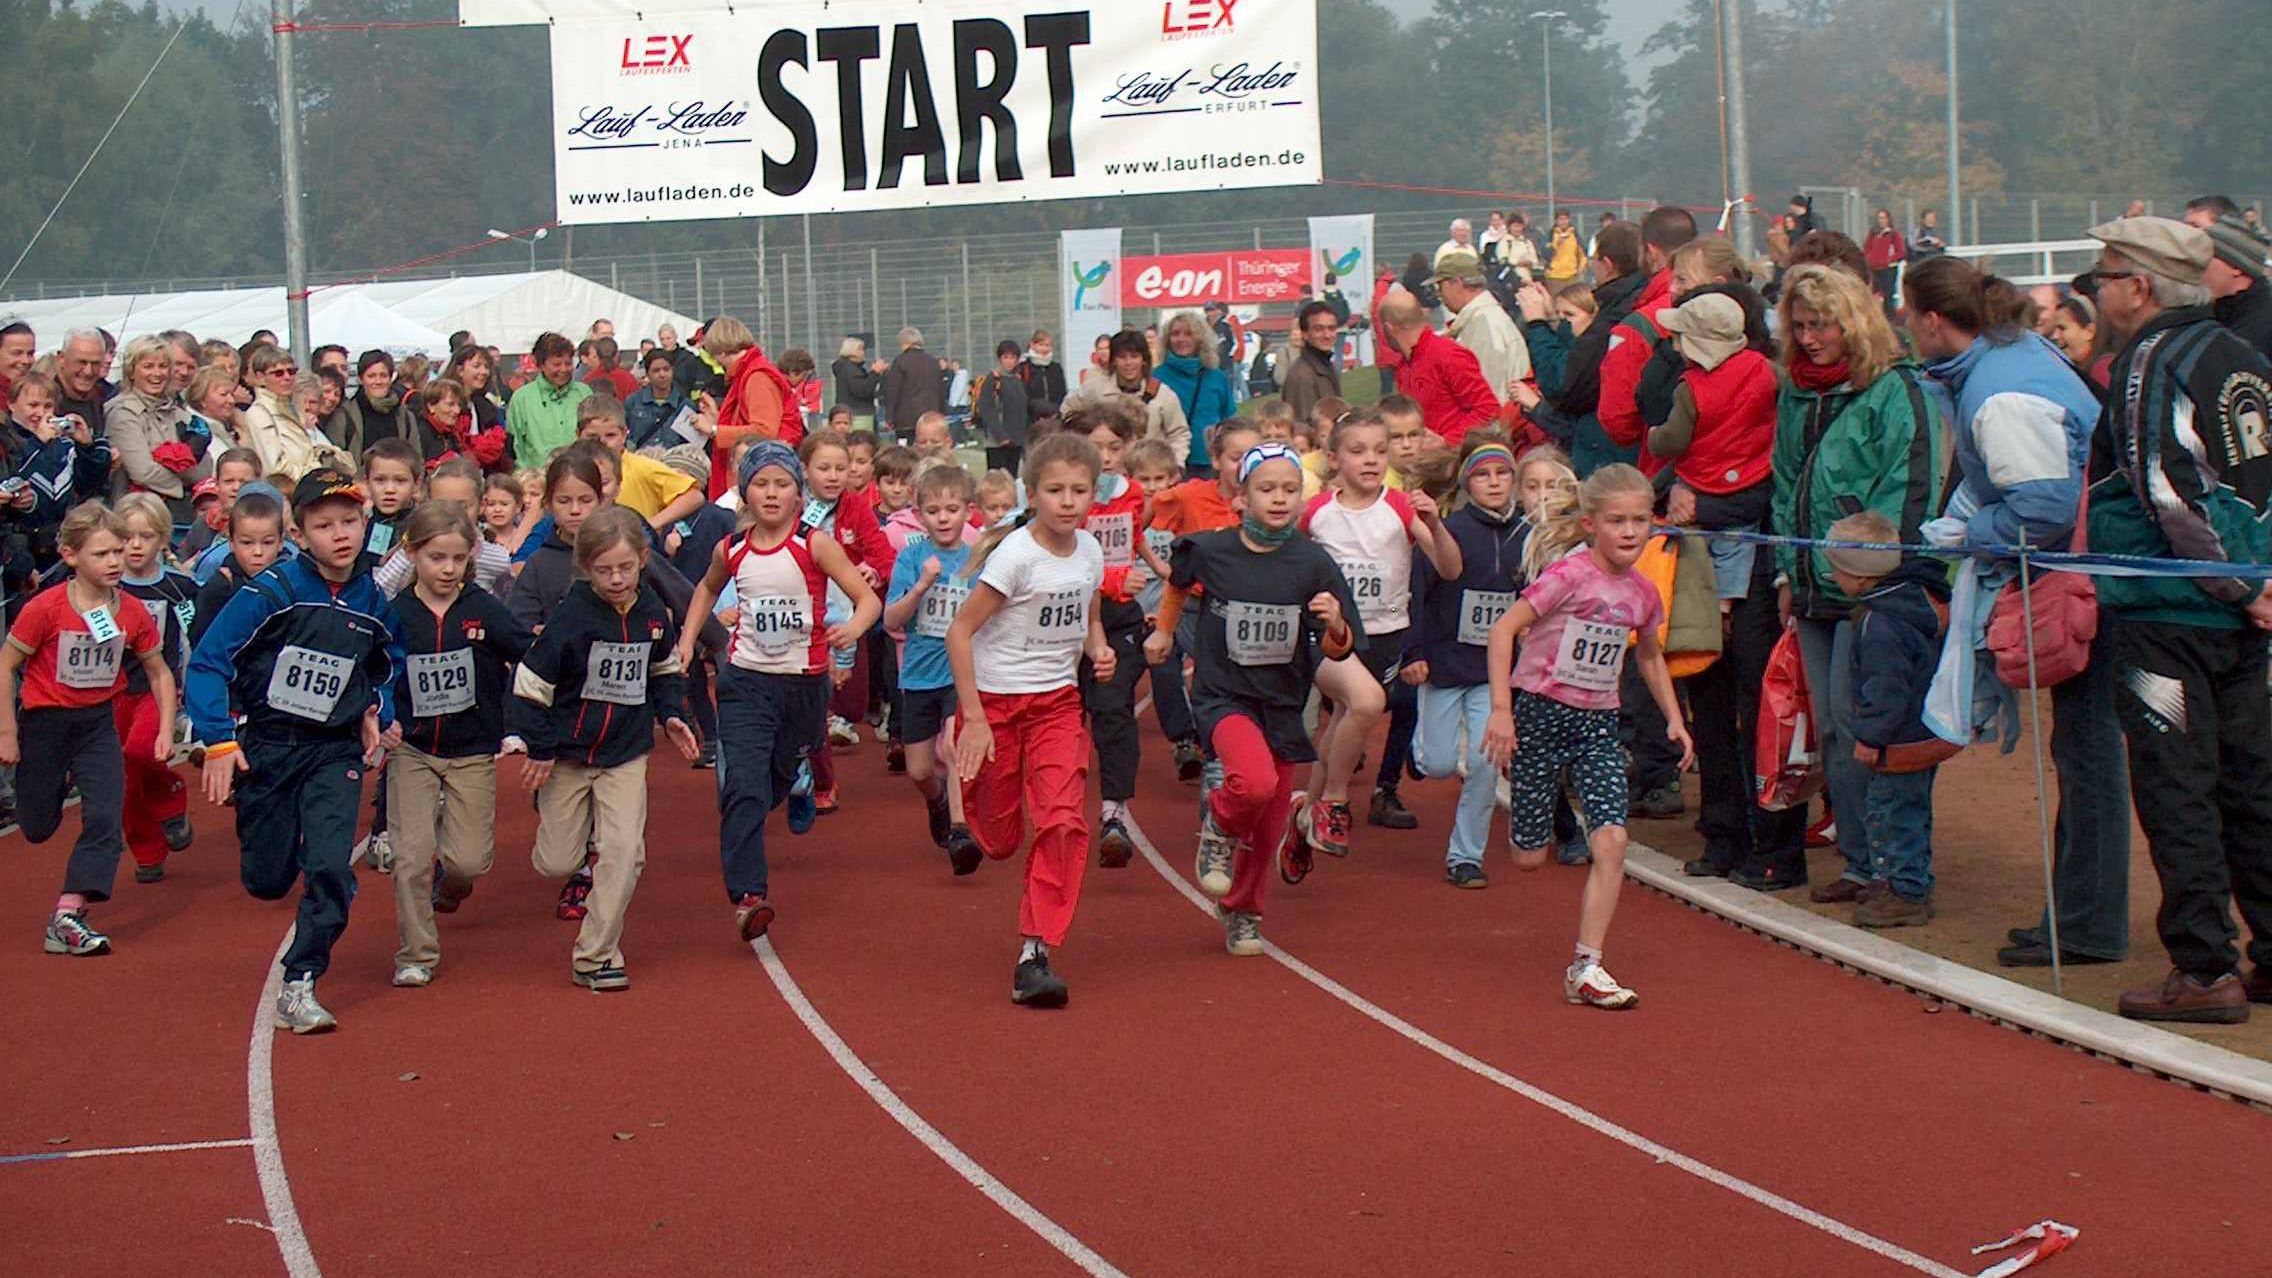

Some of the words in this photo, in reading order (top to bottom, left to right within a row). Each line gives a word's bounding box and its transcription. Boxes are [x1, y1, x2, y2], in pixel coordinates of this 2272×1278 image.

[1162, 0, 1237, 33] LEX
[622, 34, 694, 68] LEX
[757, 9, 1091, 197] START
[1205, 100, 1268, 114] ERFURT
[663, 138, 702, 150] JENA
[1104, 149, 1305, 175] www.laufladen.de
[569, 183, 754, 205] www.laufladen.de
[1237, 259, 1301, 278] Thüringer
[1238, 278, 1289, 297] Energie
[1048, 589, 1081, 600] TEAC
[1346, 577, 1382, 597] 126
[760, 598, 797, 606] TEAC
[927, 597, 963, 619] 811
[1243, 605, 1285, 615] TEAC
[90, 610, 113, 638] 8114
[756, 611, 804, 632] 8145
[1039, 602, 1083, 628] 8154
[1472, 606, 1506, 625] 812
[1238, 619, 1289, 643] 8109
[1583, 623, 1621, 637] TEAC
[68, 646, 115, 667] 8114
[297, 651, 340, 668] TEAC
[418, 653, 460, 665] TEAC
[1572, 638, 1622, 666] 8127
[286, 664, 342, 699] 8159
[418, 666, 468, 693] 8129
